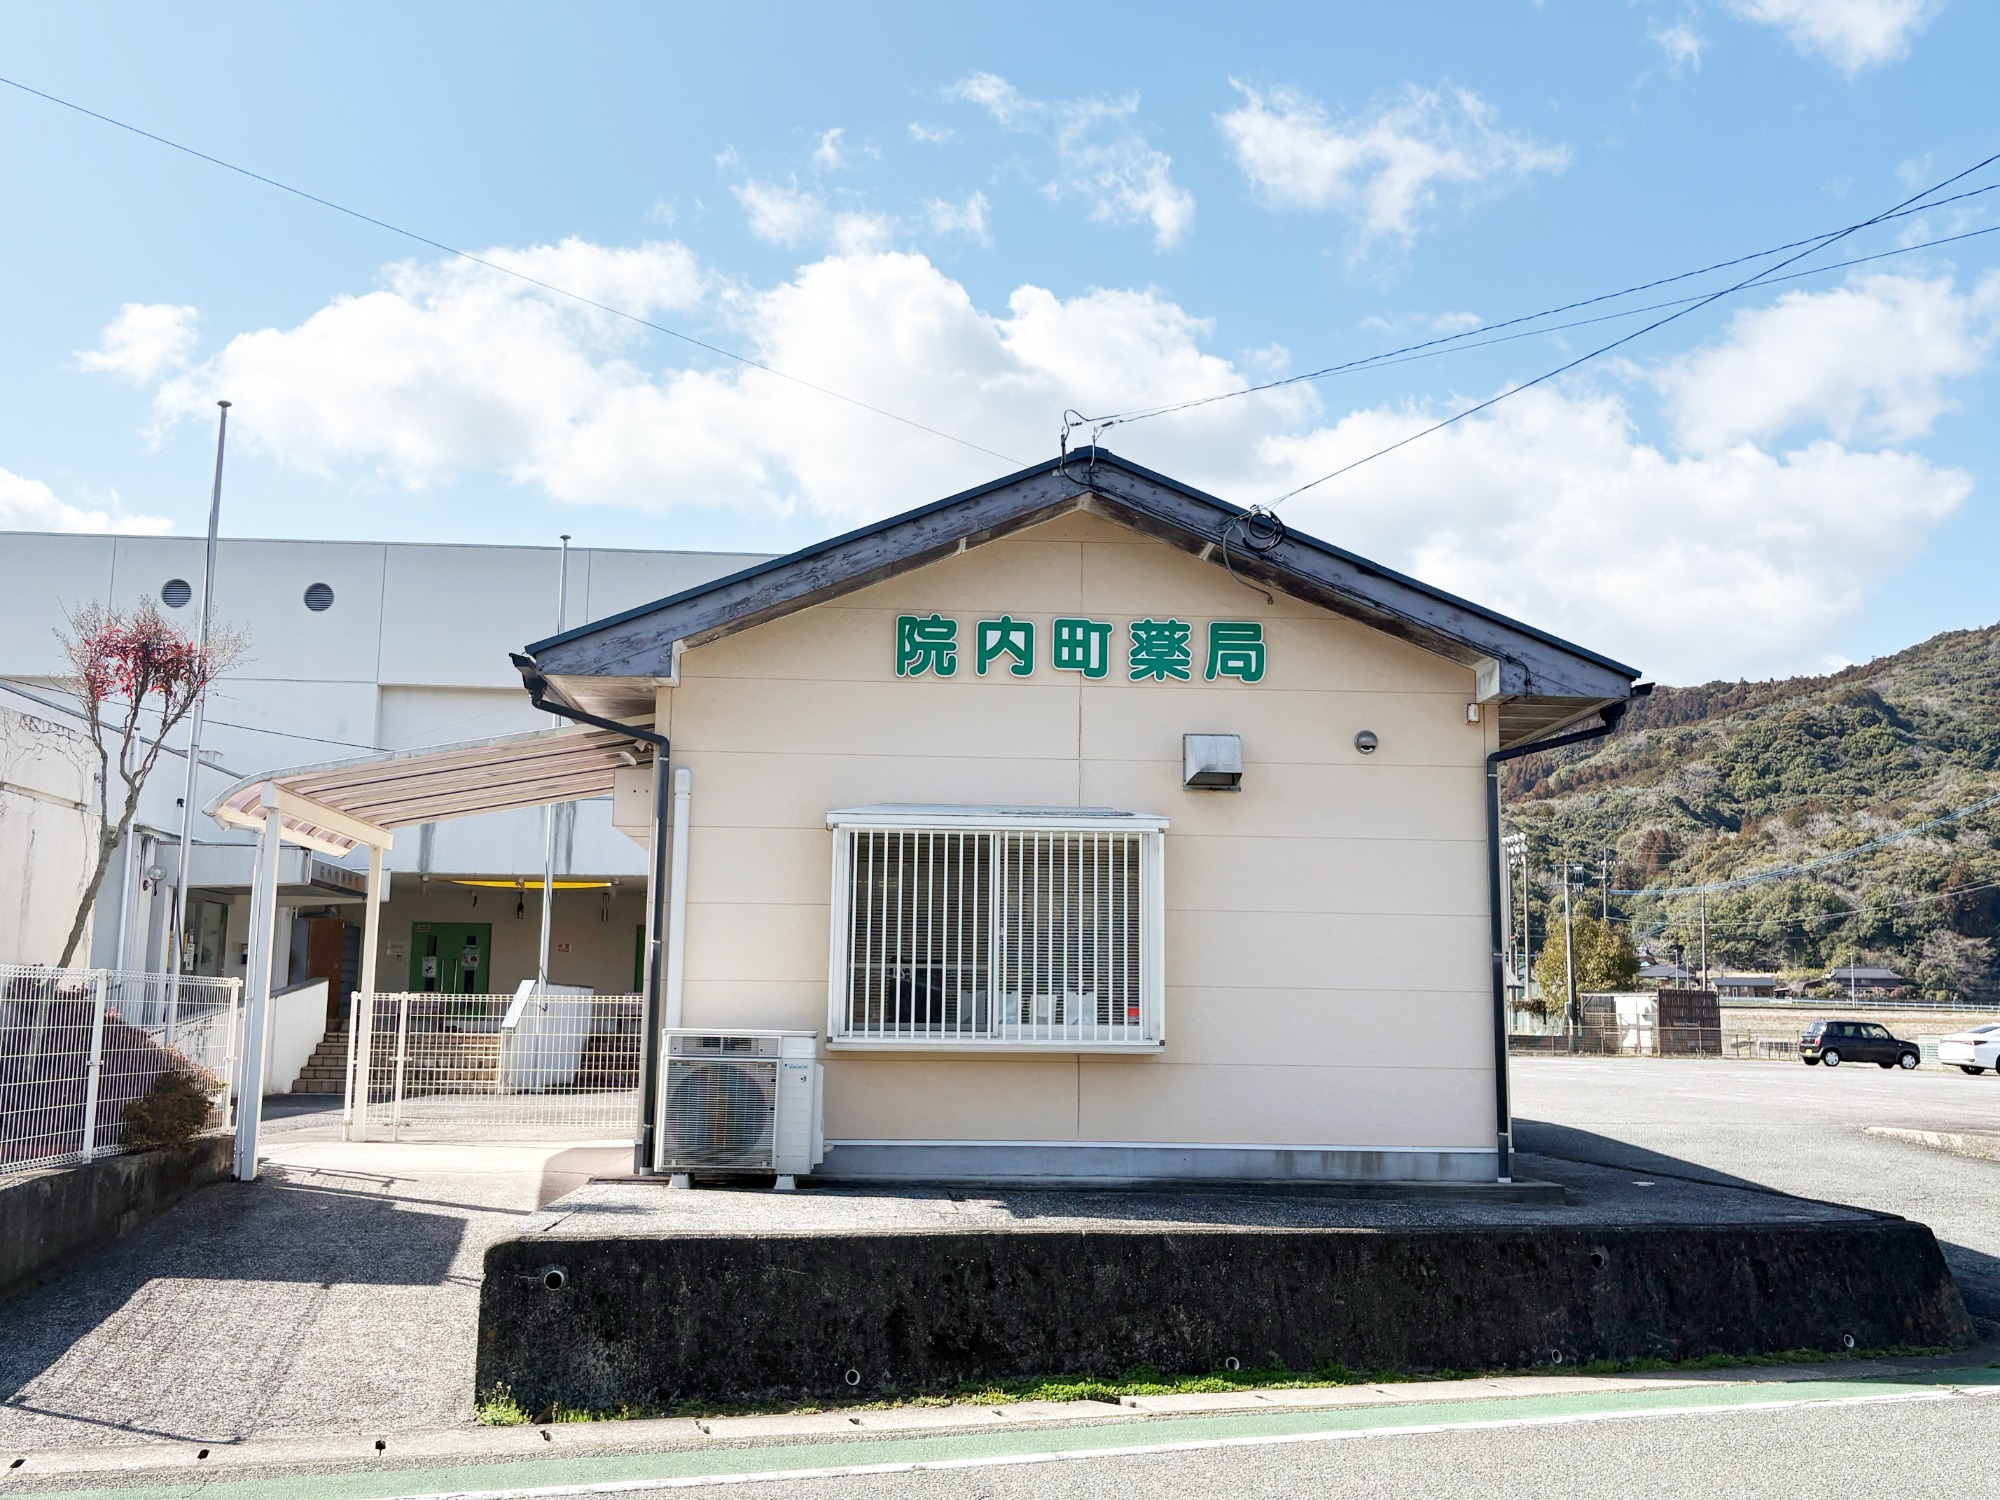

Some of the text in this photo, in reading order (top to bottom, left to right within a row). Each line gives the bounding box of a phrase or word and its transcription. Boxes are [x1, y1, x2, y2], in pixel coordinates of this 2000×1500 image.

[895, 613, 1267, 683] 院内町薬局
